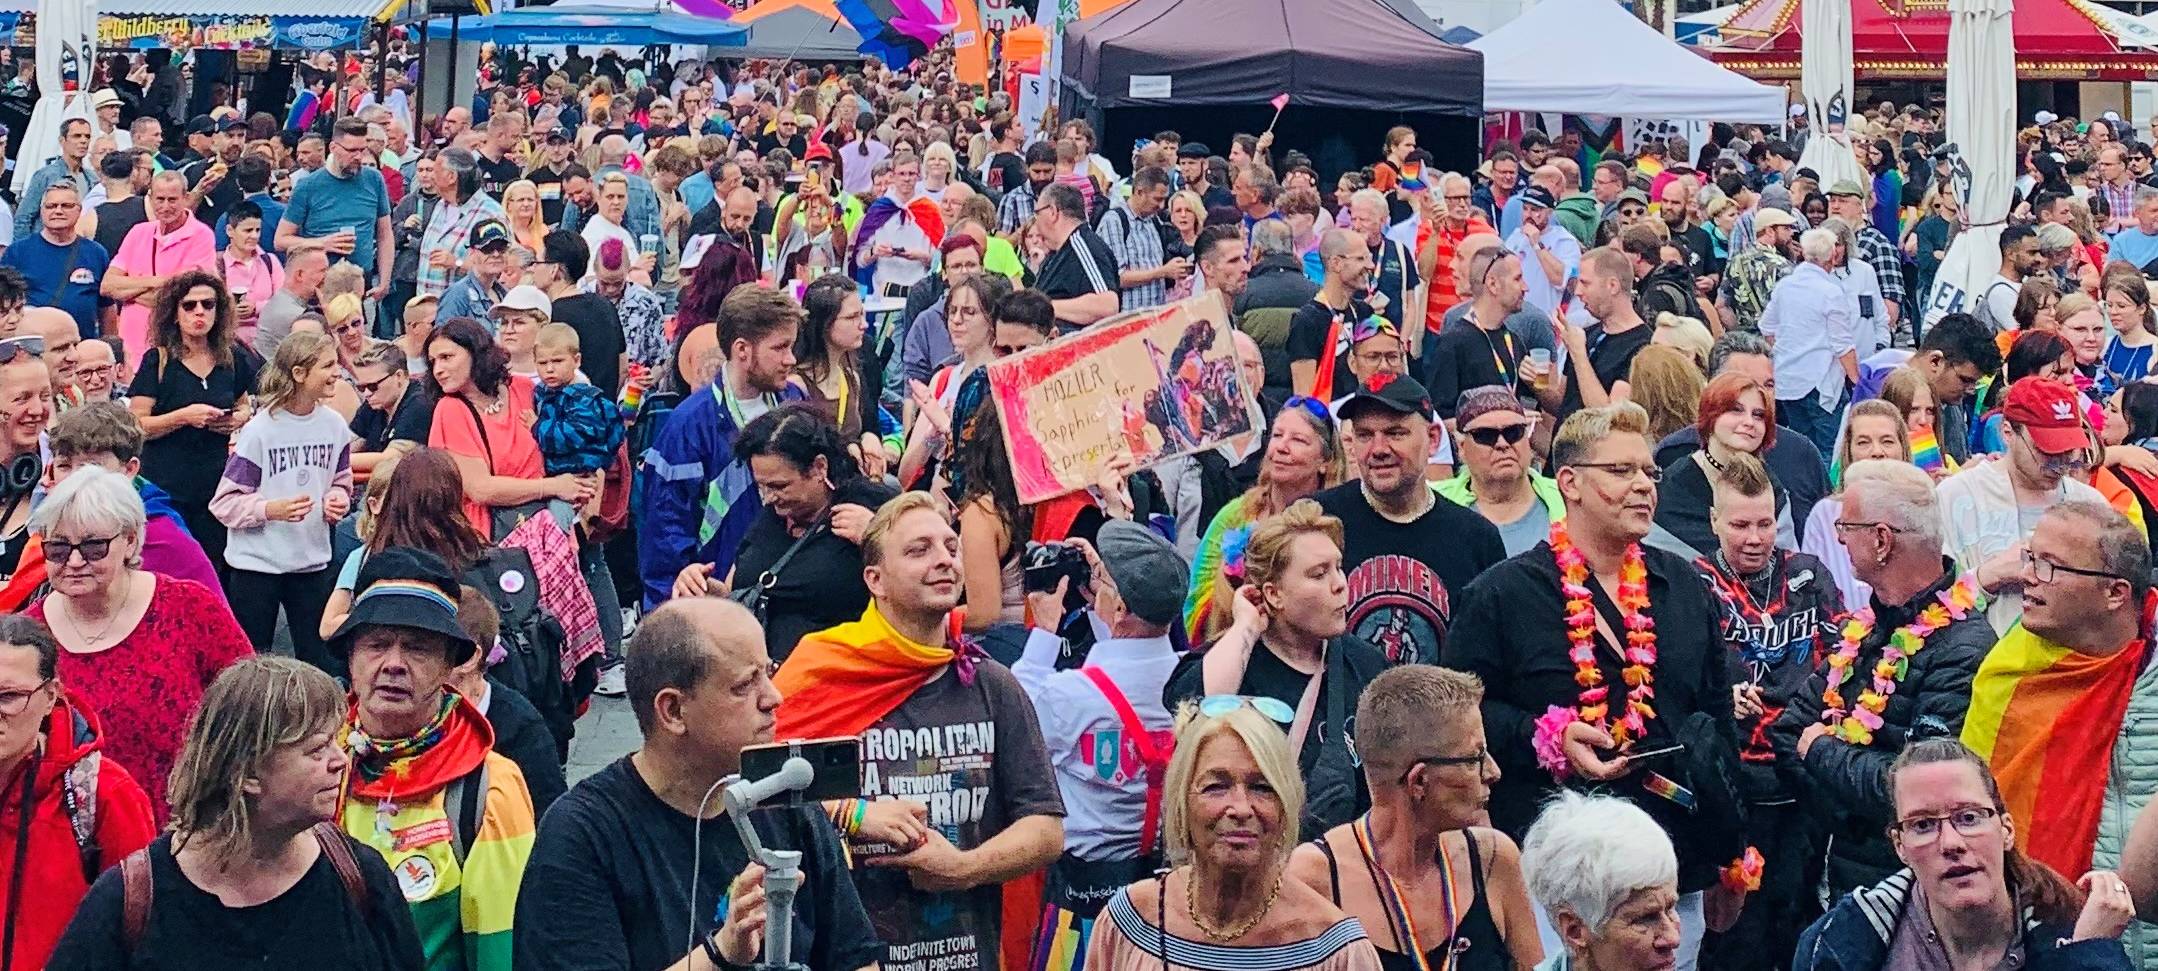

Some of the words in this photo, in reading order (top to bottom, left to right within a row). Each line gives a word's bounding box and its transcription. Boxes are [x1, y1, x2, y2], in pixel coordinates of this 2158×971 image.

[113, 16, 187, 39] Wildberry
[1114, 379, 1136, 397] for
[268, 446, 299, 477] NEW
[302, 443, 334, 470] YORK
[888, 773, 953, 795] NETWORK
[889, 940, 946, 962] INDEFINITE
[946, 935, 977, 954] TOWN
